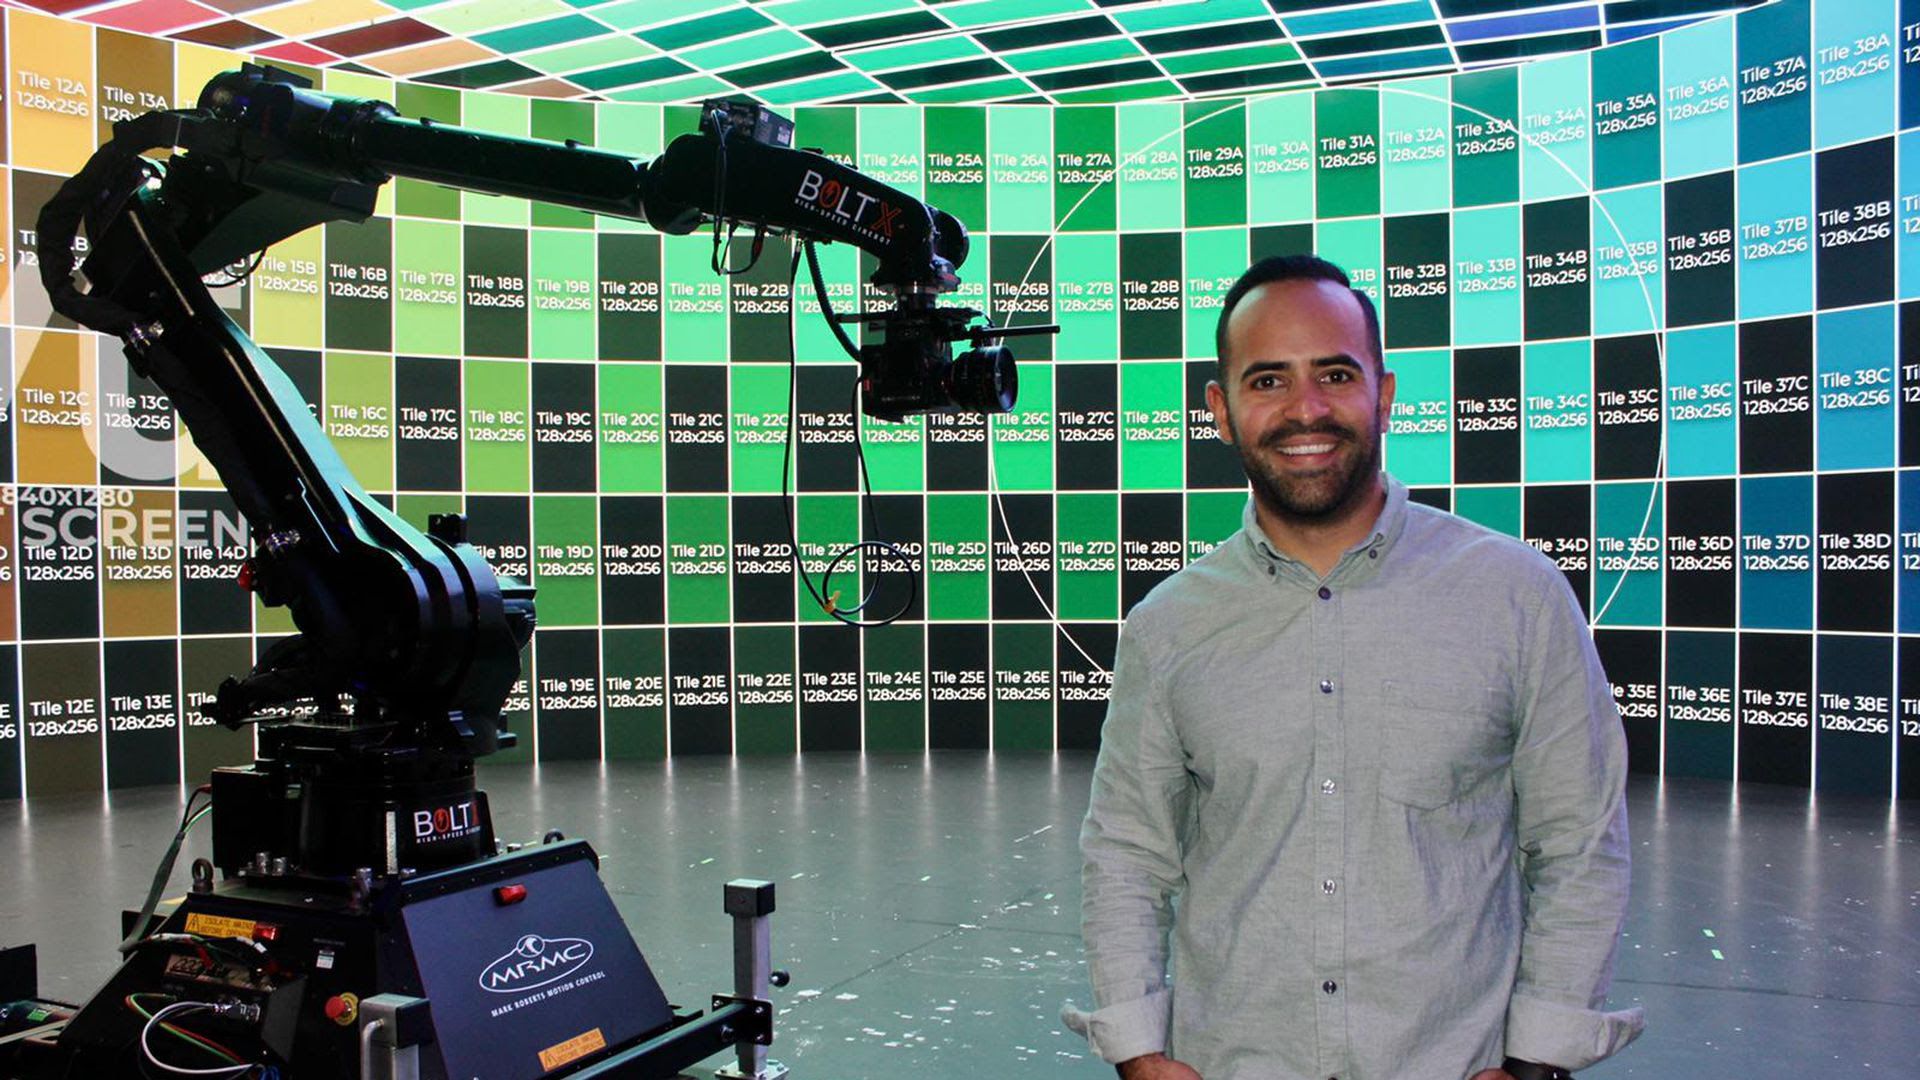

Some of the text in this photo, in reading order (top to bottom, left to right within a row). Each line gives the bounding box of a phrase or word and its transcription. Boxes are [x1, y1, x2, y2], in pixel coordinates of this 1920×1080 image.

[1819, 47, 1849, 63] Tile
[1854, 34, 1890, 55] 38A
[1741, 56, 1806, 83] Tile 37A
[1820, 55, 1889, 84] 128x256
[19, 71, 86, 96] Tile 12A
[1741, 76, 1806, 104] 128x256
[17, 91, 88, 116] 128x256
[104, 85, 169, 110] Tile 13A
[1596, 94, 1656, 115] Tile 35A
[1596, 111, 1656, 134] 128x256
[1321, 135, 1374, 150] Tile 31A
[928, 154, 982, 166] Tile 25A
[1188, 147, 1243, 161] Tile 29A
[1320, 151, 1376, 168] 128x256
[929, 171, 983, 182] 128x256
[1188, 163, 1243, 178] 128x256
[798, 169, 902, 239] BOLT X
[794, 198, 848, 226] HIGH-SPEED
[1819, 210, 1850, 226] Tile
[1854, 201, 1890, 220] 38B
[1742, 216, 1807, 238] Tile 37B
[1820, 222, 1890, 247] 128x256
[1668, 229, 1731, 250] Tile 36B
[1743, 237, 1807, 259] 128x256
[1526, 250, 1587, 268] Tile 34B
[1669, 249, 1731, 270] 128x256
[330, 264, 387, 281] Tile 16B
[1388, 264, 1446, 279] Tile 32B
[1528, 269, 1586, 286] 128x256
[468, 275, 523, 290] Tile 18B
[601, 282, 658, 294] Tile 20B
[1123, 281, 1179, 293] Tile 28B
[1388, 281, 1446, 297] 128x256
[330, 282, 388, 299] 128x256
[468, 293, 525, 307] 128x256
[602, 299, 658, 311] 128x256
[1124, 297, 1179, 310] 128x256
[1743, 376, 1807, 394] Tile 37C
[1821, 368, 1890, 387] Tile 38C
[24, 389, 90, 407] Tile 12C
[106, 393, 169, 410] Tile 13C
[1458, 398, 1516, 413] Tile 33C
[1743, 397, 1809, 414] 128x256
[1822, 389, 1890, 408] 128x256
[21, 409, 92, 426] 128x256
[105, 412, 171, 430] 128x256
[401, 408, 455, 422] Tile 17C
[800, 414, 853, 426] Tile 23C
[930, 413, 984, 425] Tile 25C
[1059, 412, 1114, 424] Tile 27C
[1458, 416, 1517, 431] 128x256
[400, 426, 458, 439] 128x256
[800, 431, 855, 442] 128x256
[930, 430, 984, 442] 128x256
[1059, 429, 1114, 441] 128x256
[22, 508, 248, 547] SCREEN
[930, 543, 986, 554] Tile 25D
[1124, 542, 1181, 553] Tile 28D
[1669, 536, 1733, 550] Tile 36D
[1743, 535, 1810, 549] Tile 37D
[1820, 534, 1891, 549] Tile 38D
[25, 546, 93, 560] Tile 12D
[107, 546, 171, 560] Tile 13D
[184, 546, 247, 560] Tile 14D
[538, 546, 593, 558] Tile 19D
[735, 544, 791, 556] Tile 22D
[538, 563, 594, 575] 128x256
[736, 561, 791, 573] 128x256
[931, 559, 985, 571] 128x256
[1125, 558, 1181, 571] 128x256
[1670, 556, 1732, 570] 128x256
[1744, 555, 1809, 569] 128x256
[1821, 555, 1889, 569] 128x256
[24, 566, 94, 580] 128x256
[106, 565, 172, 580] 128x256
[803, 673, 856, 685] Tile 23E
[932, 671, 985, 683] Tile 25E
[541, 679, 594, 691] Tile 19E
[803, 689, 857, 702] 128x256
[932, 688, 986, 700] 128x256
[1668, 686, 1730, 702] Tile 36E
[1743, 690, 1807, 707] Tile 37E
[30, 699, 94, 716] Tile 12E
[112, 695, 172, 711] Tile 13E
[540, 696, 597, 709] 128x256
[1820, 694, 1888, 712] Tile 38E
[1669, 705, 1731, 722] 128x256
[1742, 710, 1808, 727] 128x256
[29, 719, 98, 736] 128x256
[110, 714, 175, 730] 128x256
[1820, 715, 1888, 733] 128x256
[413, 802, 470, 837] BOLT
[491, 943, 586, 988] MRMC
[491, 971, 606, 1017] MARK ROBERTS MOTION CONTROL
